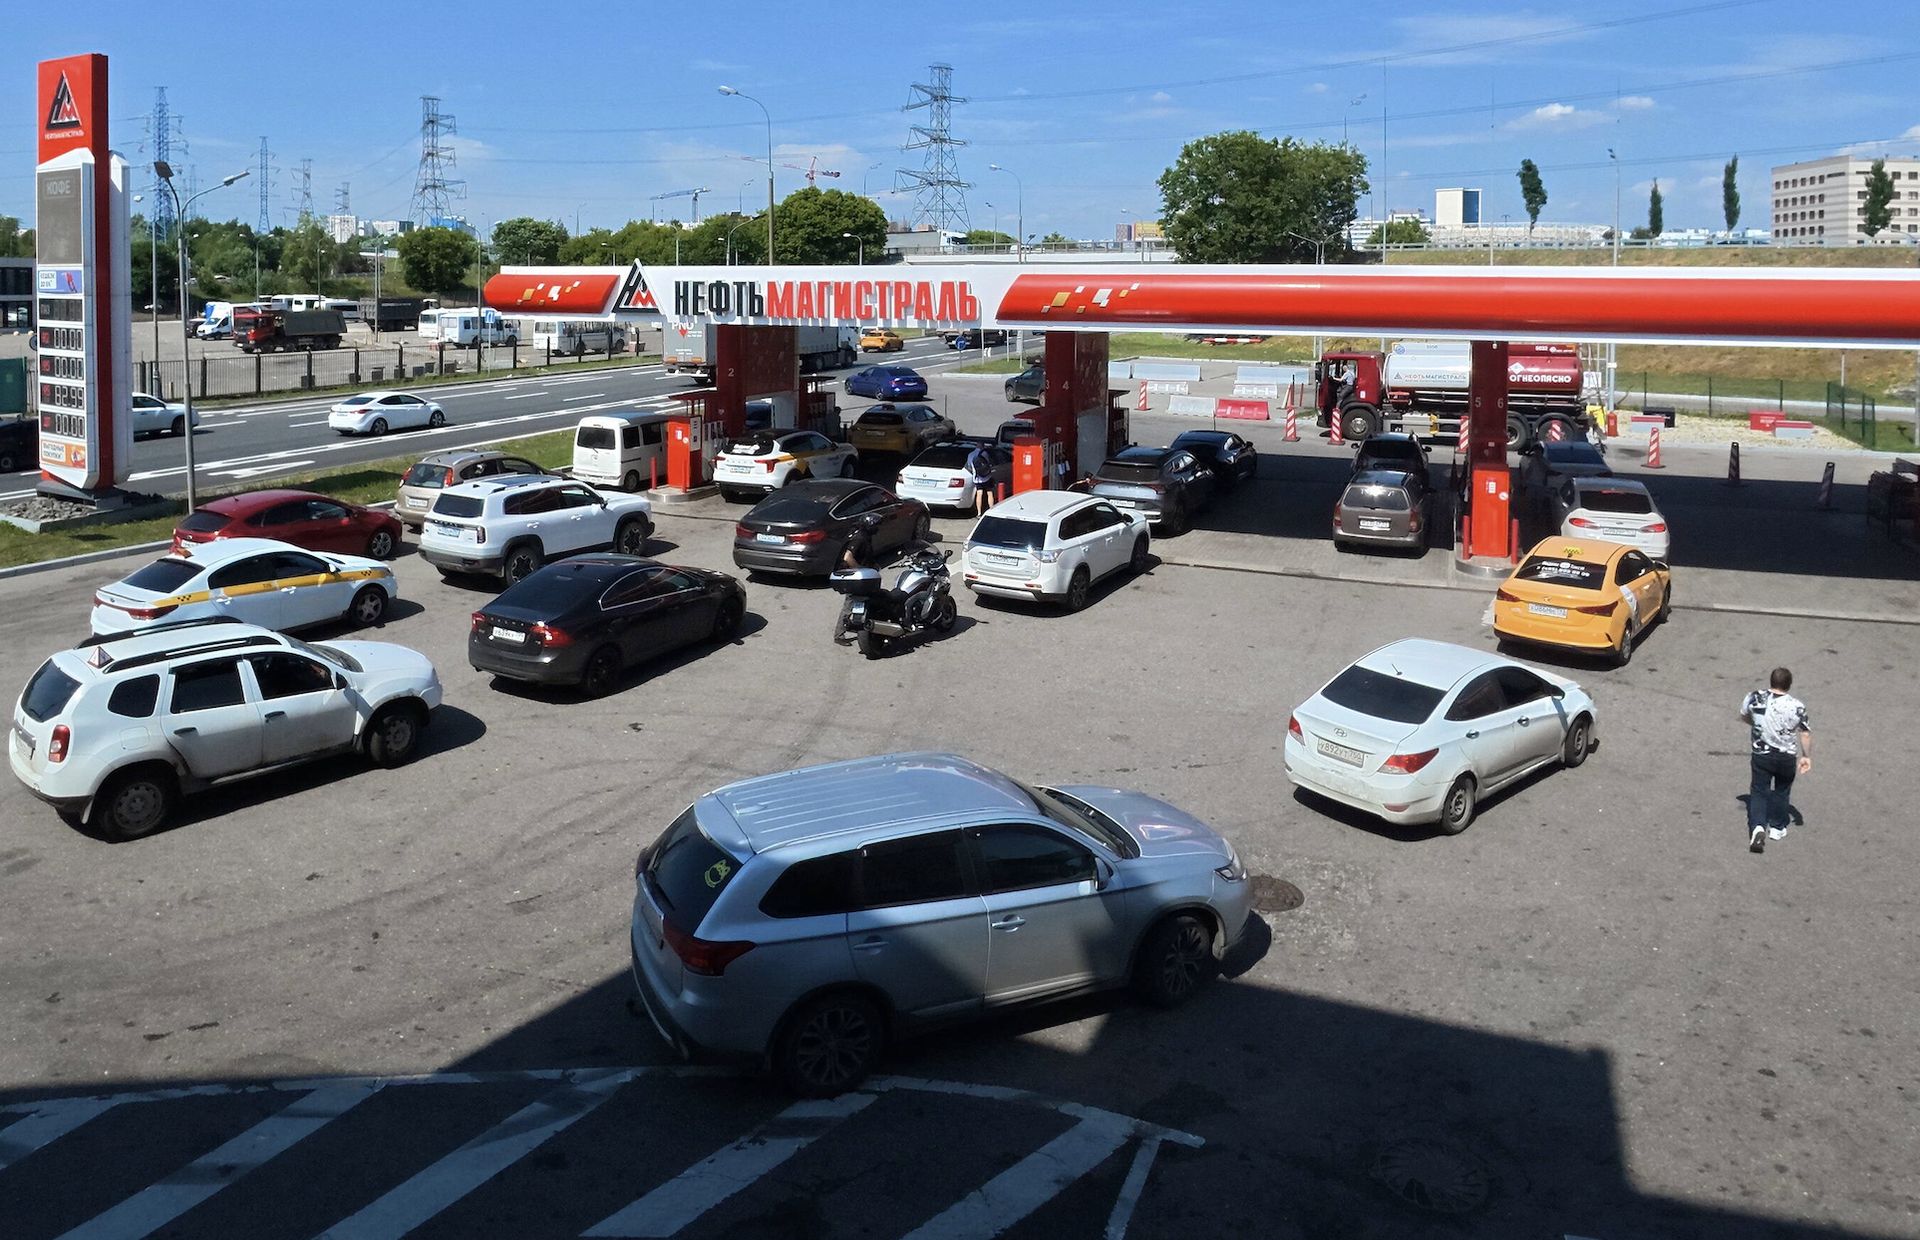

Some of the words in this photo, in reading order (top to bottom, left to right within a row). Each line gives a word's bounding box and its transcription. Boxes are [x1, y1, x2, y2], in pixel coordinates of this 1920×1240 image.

[47, 180, 71, 195] КОФЕ
[674, 280, 977, 321] НЕФТЬМАГИСТРАЛЬ
[728, 367, 735, 377] 2
[1509, 374, 1572, 383] ОГНЕОПАСНО
[1062, 380, 1070, 390] 4
[55, 385, 84, 408] 82.99
[1474, 396, 1481, 408] 5
[1497, 397, 1504, 409] 6
